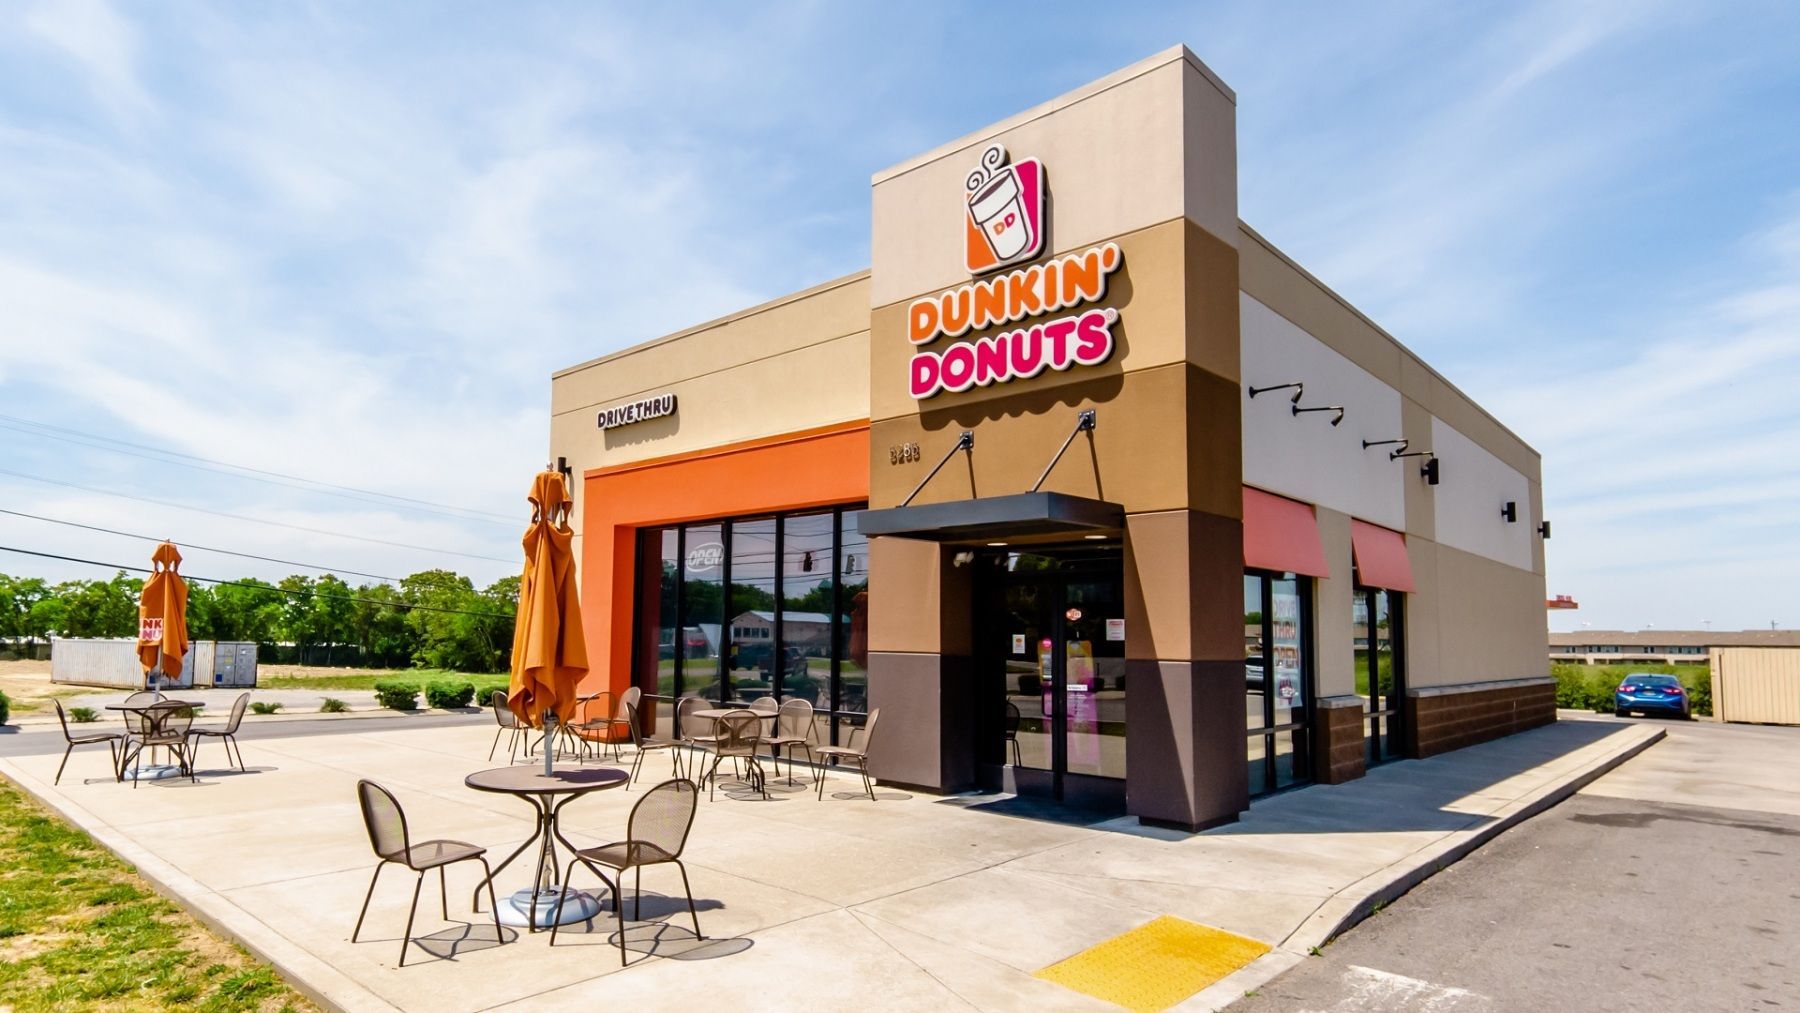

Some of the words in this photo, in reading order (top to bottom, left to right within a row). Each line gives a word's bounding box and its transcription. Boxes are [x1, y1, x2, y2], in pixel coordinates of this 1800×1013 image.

[993, 212, 1016, 236] DD
[910, 246, 1116, 343] DUNKIN'
[910, 310, 1110, 396] DONUTS
[597, 404, 634, 429] DRIVE
[635, 394, 672, 419] THRU
[687, 547, 722, 567] OPEN
[1273, 620, 1296, 640] THRU
